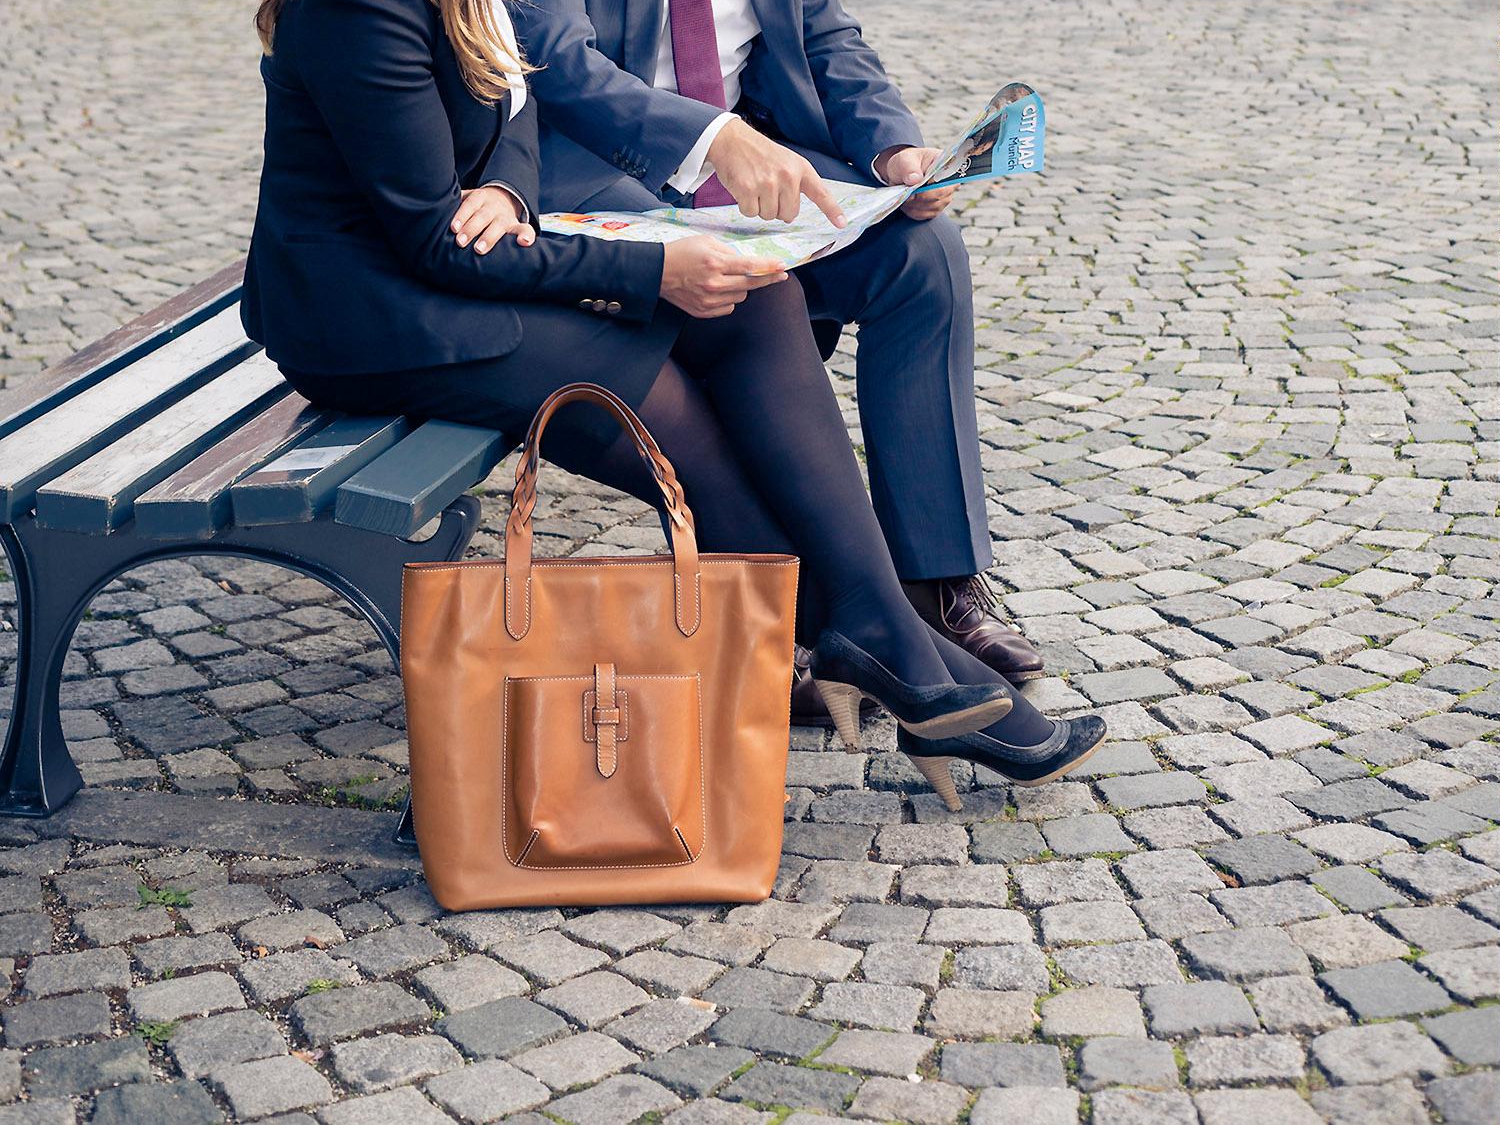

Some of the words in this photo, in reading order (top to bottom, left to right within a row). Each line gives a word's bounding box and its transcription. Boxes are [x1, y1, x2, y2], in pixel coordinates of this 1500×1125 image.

[1019, 104, 1037, 133] CITY
[1008, 136, 1018, 171] Munich
[1018, 136, 1035, 169] MAP
